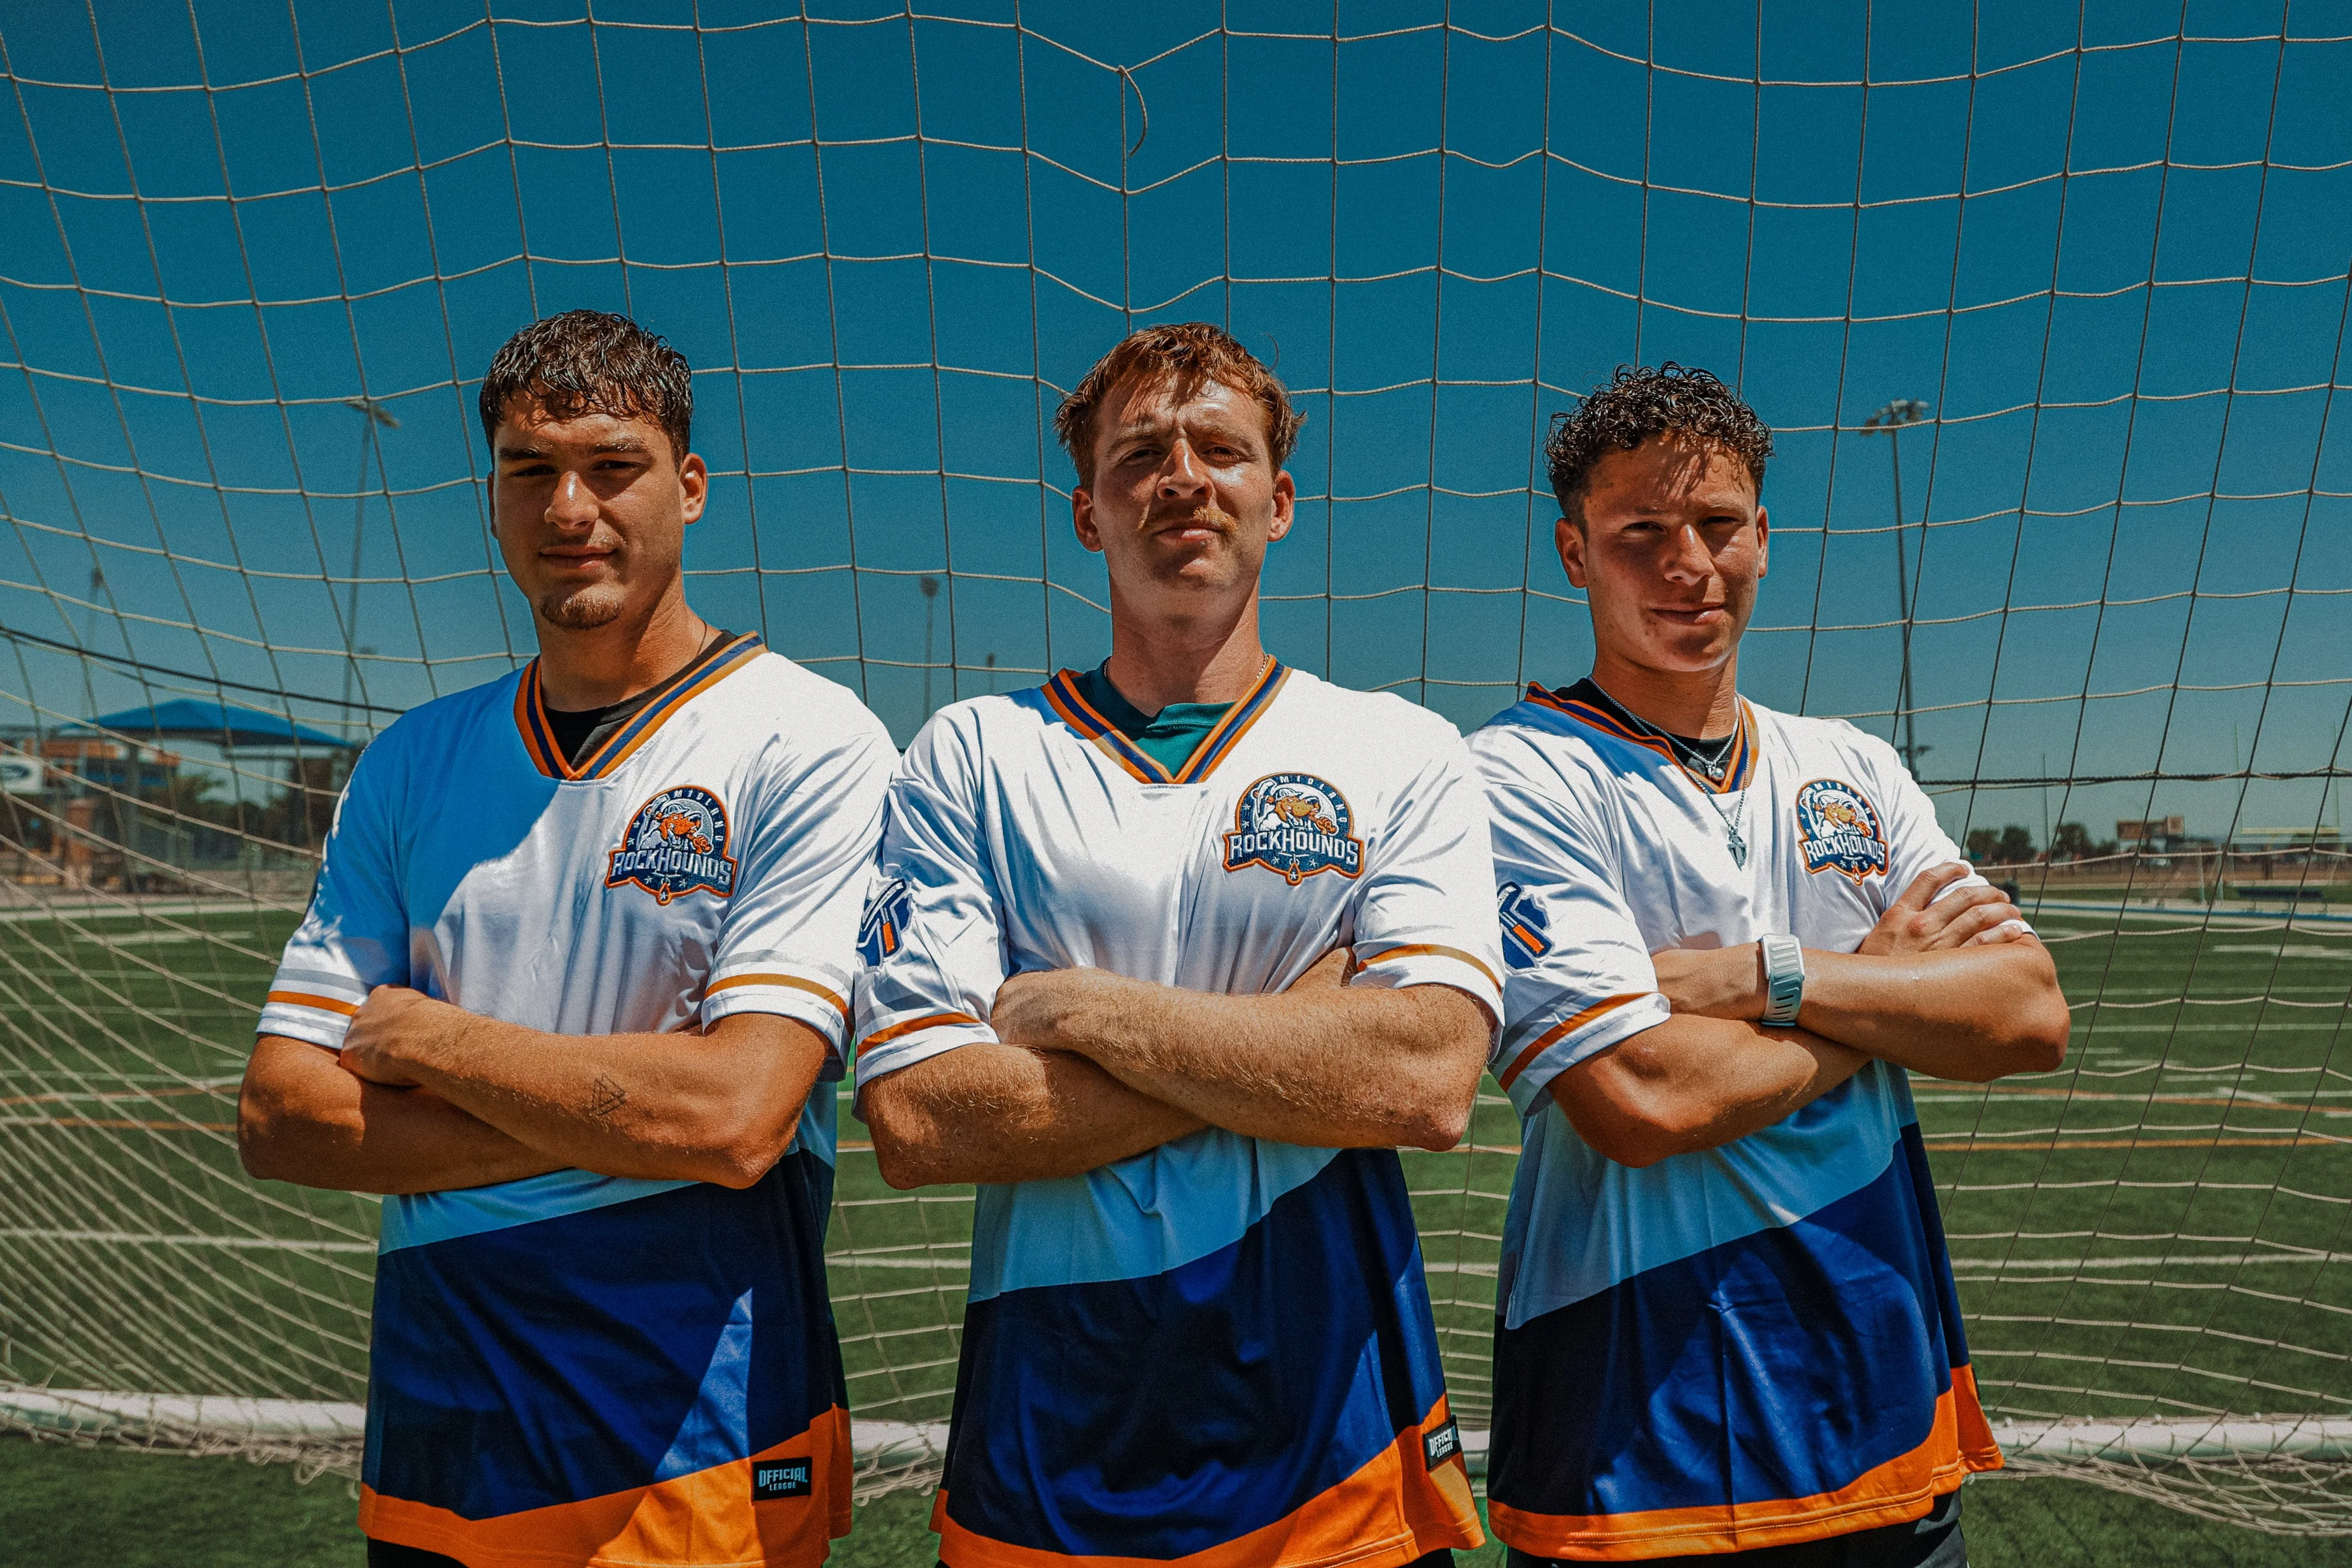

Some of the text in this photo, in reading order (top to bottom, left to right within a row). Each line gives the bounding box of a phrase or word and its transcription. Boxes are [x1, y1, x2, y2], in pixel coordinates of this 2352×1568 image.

[673, 789, 725, 841] MIDLAND
[1279, 775, 1348, 823] MIDLAND
[1814, 781, 1877, 826] MIDLAND
[1229, 828, 1360, 866] ROCKHOUNDS
[1803, 833, 1886, 864] ROCKHOUNDS
[610, 847, 732, 886] ROCKHOUNDS
[758, 1466, 808, 1488] OFFICIAL
[769, 1481, 797, 1491] LEAGUE
